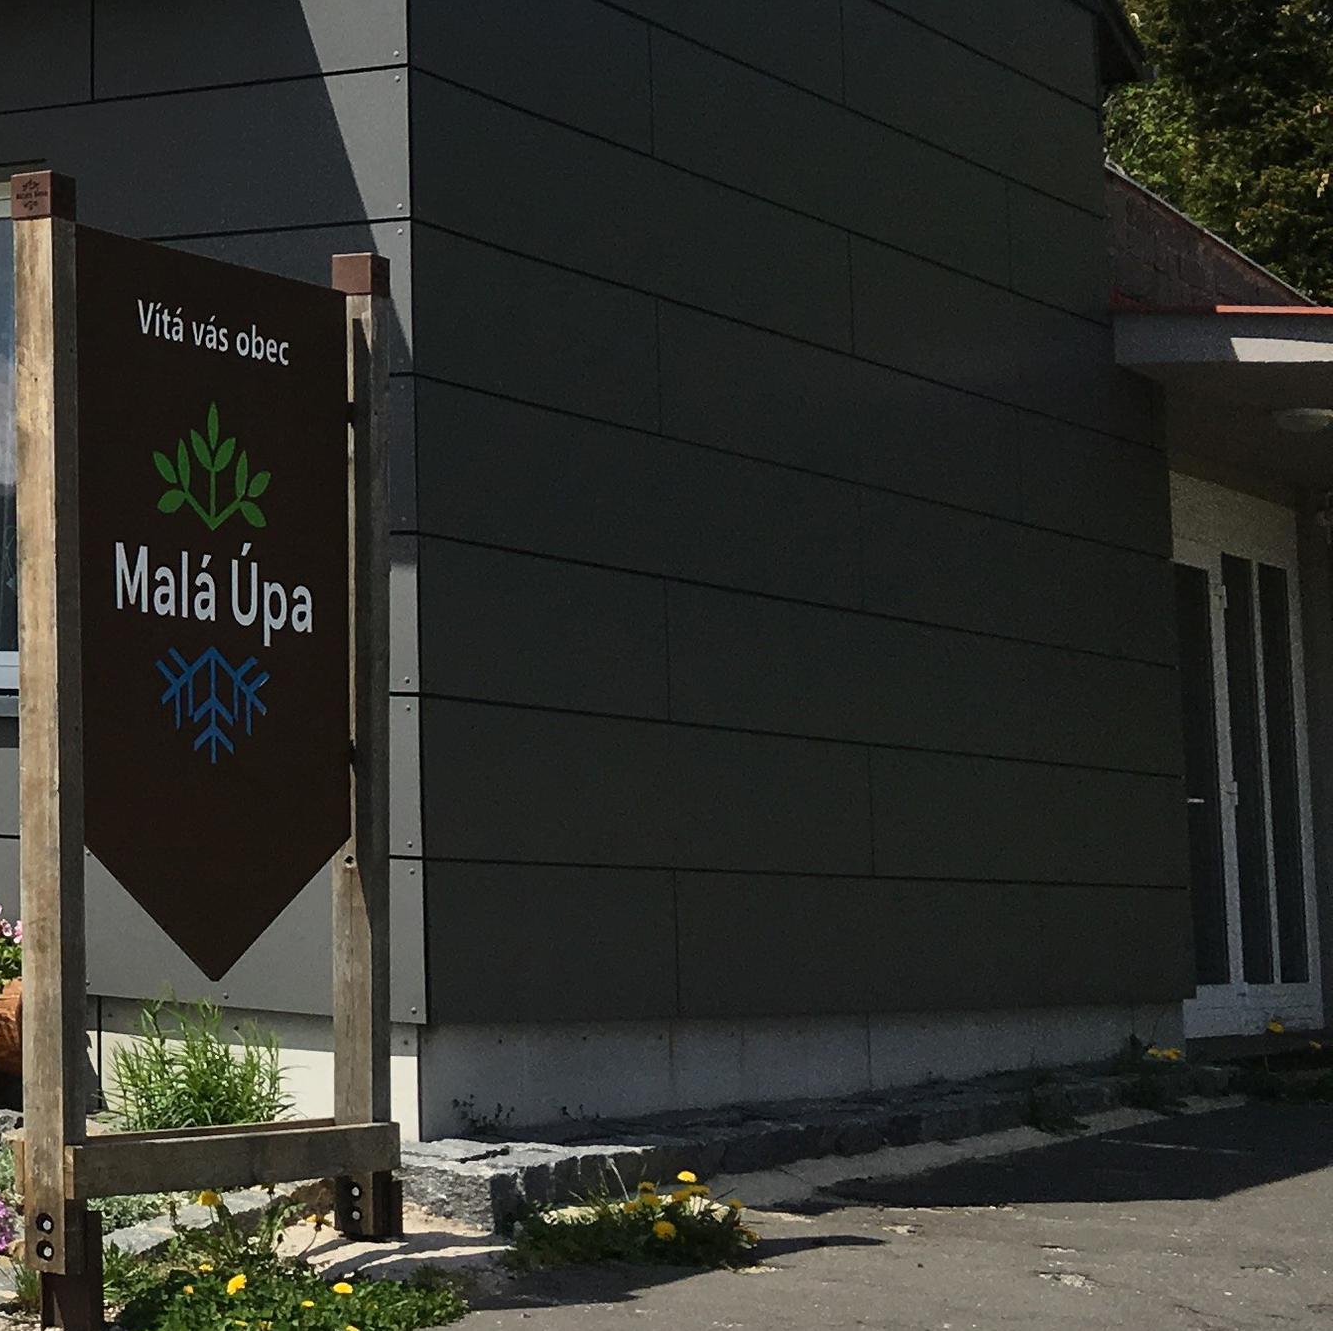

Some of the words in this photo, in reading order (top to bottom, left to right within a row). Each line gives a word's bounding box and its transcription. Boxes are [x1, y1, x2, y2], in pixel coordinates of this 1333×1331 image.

[136, 299, 184, 343] Vítá
[191, 315, 229, 352] vás
[236, 324, 290, 366] obec
[115, 541, 217, 622] Malá
[231, 542, 313, 647] Úpa
